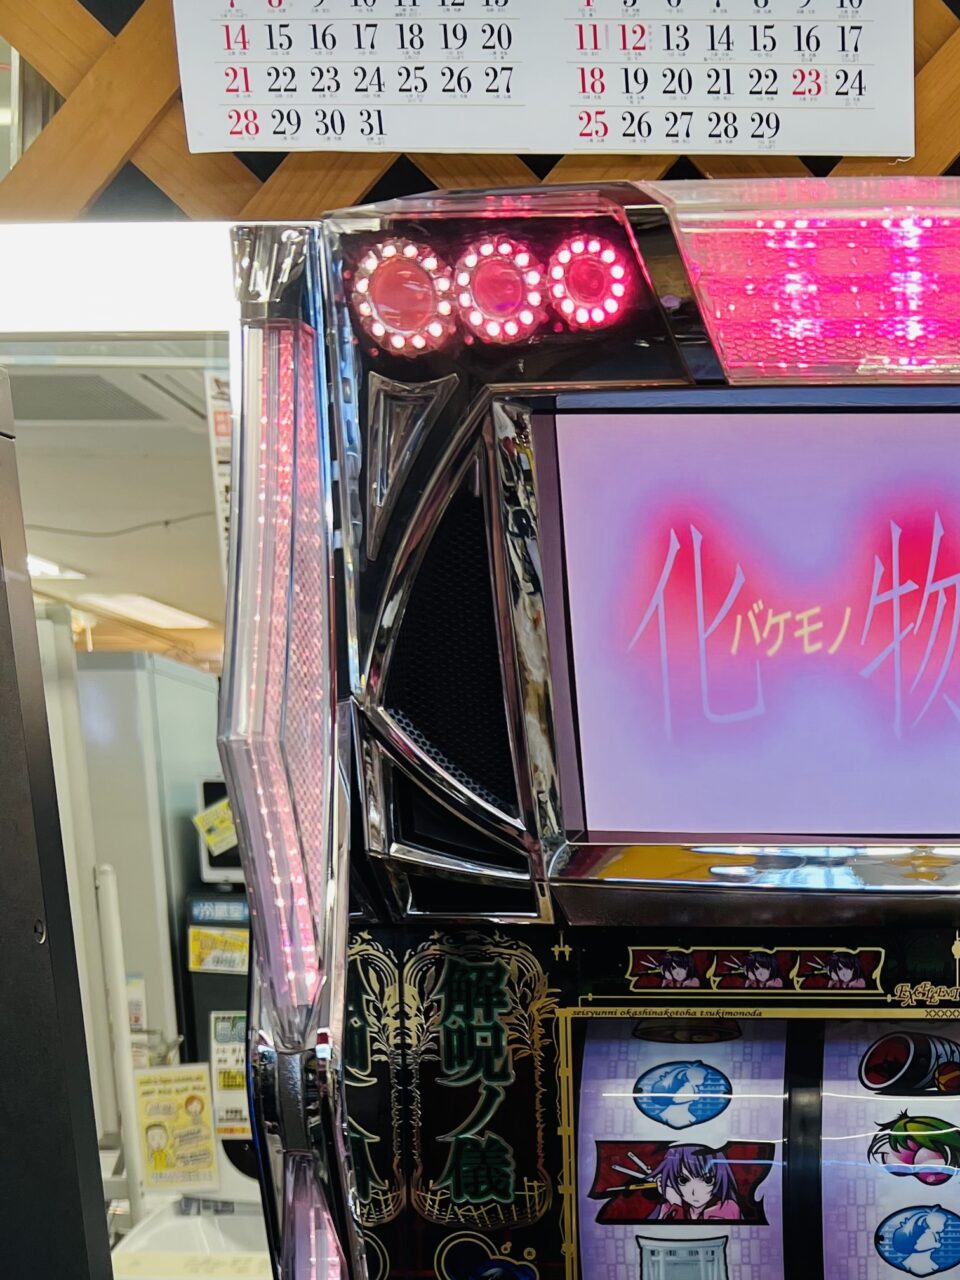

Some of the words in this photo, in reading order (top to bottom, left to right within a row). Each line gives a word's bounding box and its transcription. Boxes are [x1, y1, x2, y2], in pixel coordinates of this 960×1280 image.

[223, 23, 250, 50] 14
[265, 23, 293, 50] 15
[309, 23, 337, 50] 16
[352, 23, 378, 50] 17
[396, 23, 425, 50] 18
[439, 23, 468, 50] 19
[481, 23, 513, 50] 20
[575, 24, 600, 51] 11
[617, 24, 647, 51] 12
[661, 24, 690, 51] 13
[706, 25, 734, 52] 14
[749, 25, 777, 52] 15
[792, 26, 821, 53] 16
[836, 26, 864, 53] 17
[224, 66, 253, 93] 21
[266, 66, 298, 93] 22
[310, 66, 341, 93] 23
[353, 66, 385, 93] 24
[397, 66, 428, 93] 25
[440, 66, 472, 93] 26
[484, 66, 514, 93] 27
[576, 67, 606, 94] 18
[620, 67, 649, 94] 19
[662, 67, 693, 94] 20
[706, 68, 735, 95] 21
[748, 68, 779, 95] 22
[792, 69, 822, 96] 23
[835, 69, 866, 96] 24
[228, 109, 260, 136] 28
[271, 109, 302, 136] 29
[315, 109, 346, 136] 30
[359, 109, 388, 136] 31
[578, 111, 609, 138] 25
[621, 111, 652, 138] 26
[664, 111, 694, 138] 27
[707, 111, 739, 138] 28
[750, 111, 781, 138] 29
[626, 523, 766, 739] 化
[730, 599, 852, 657] バケモノ
